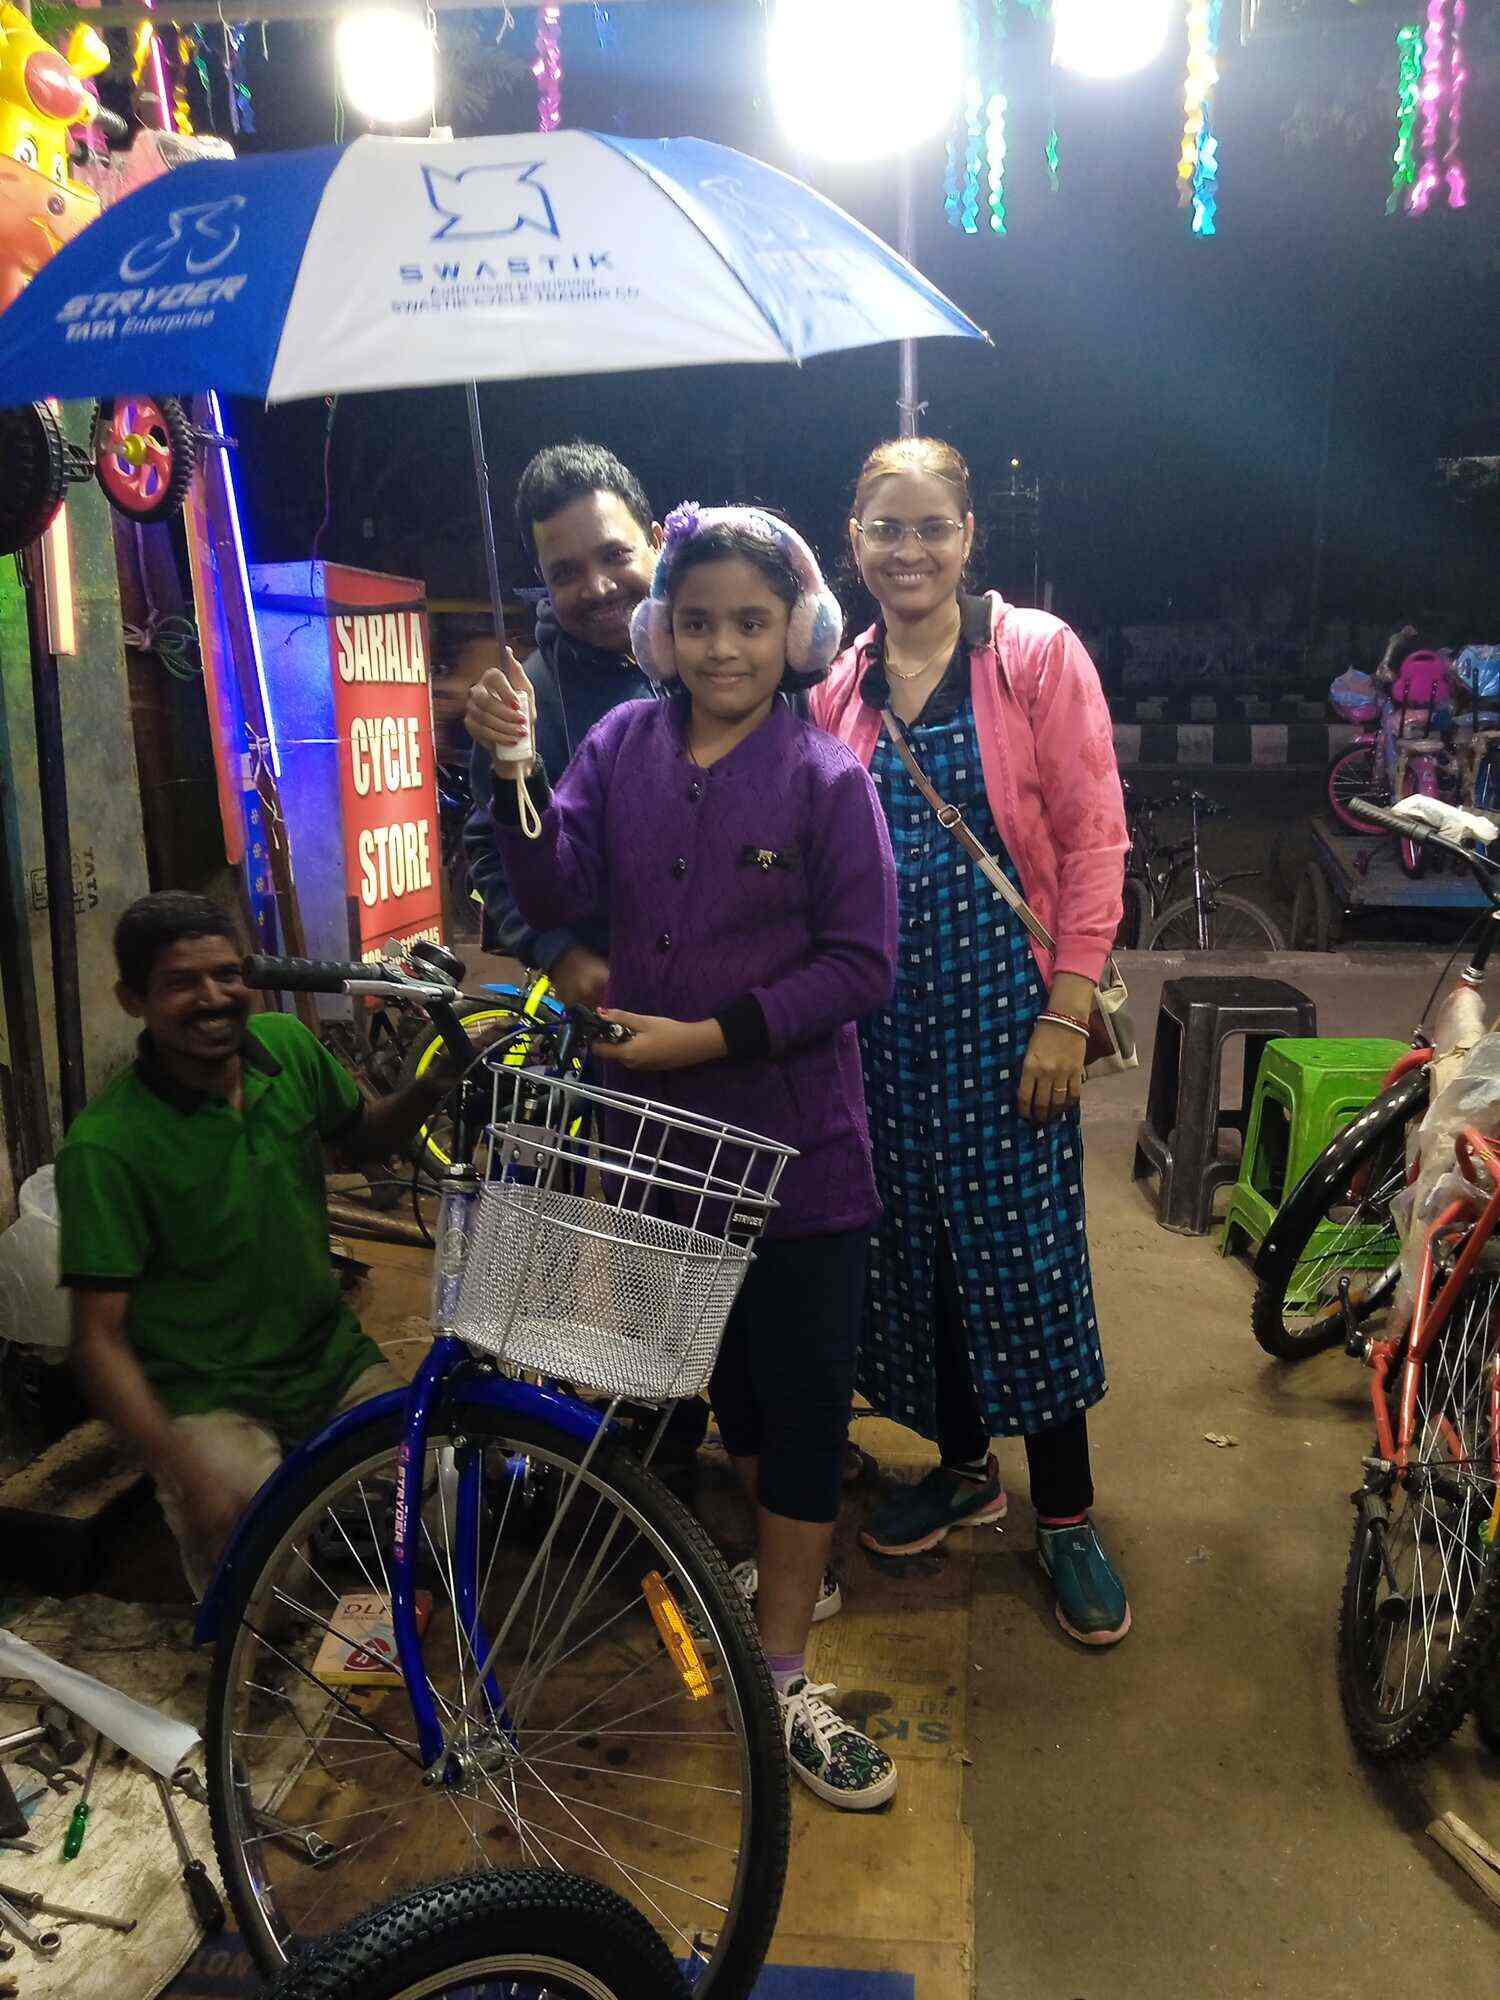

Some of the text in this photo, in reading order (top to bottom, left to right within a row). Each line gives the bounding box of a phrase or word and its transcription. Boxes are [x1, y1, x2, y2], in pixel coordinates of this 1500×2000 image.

[399, 251, 615, 282] SWASTIK
[56, 273, 248, 323] STRYDER
[64, 308, 217, 344] TATA Enterprise
[335, 612, 427, 684] SARALA
[350, 716, 424, 796] CYCLE
[358, 819, 433, 907] STORE
[732, 1213, 763, 1227] STRYDER
[394, 1464, 406, 1543] STRYDER
